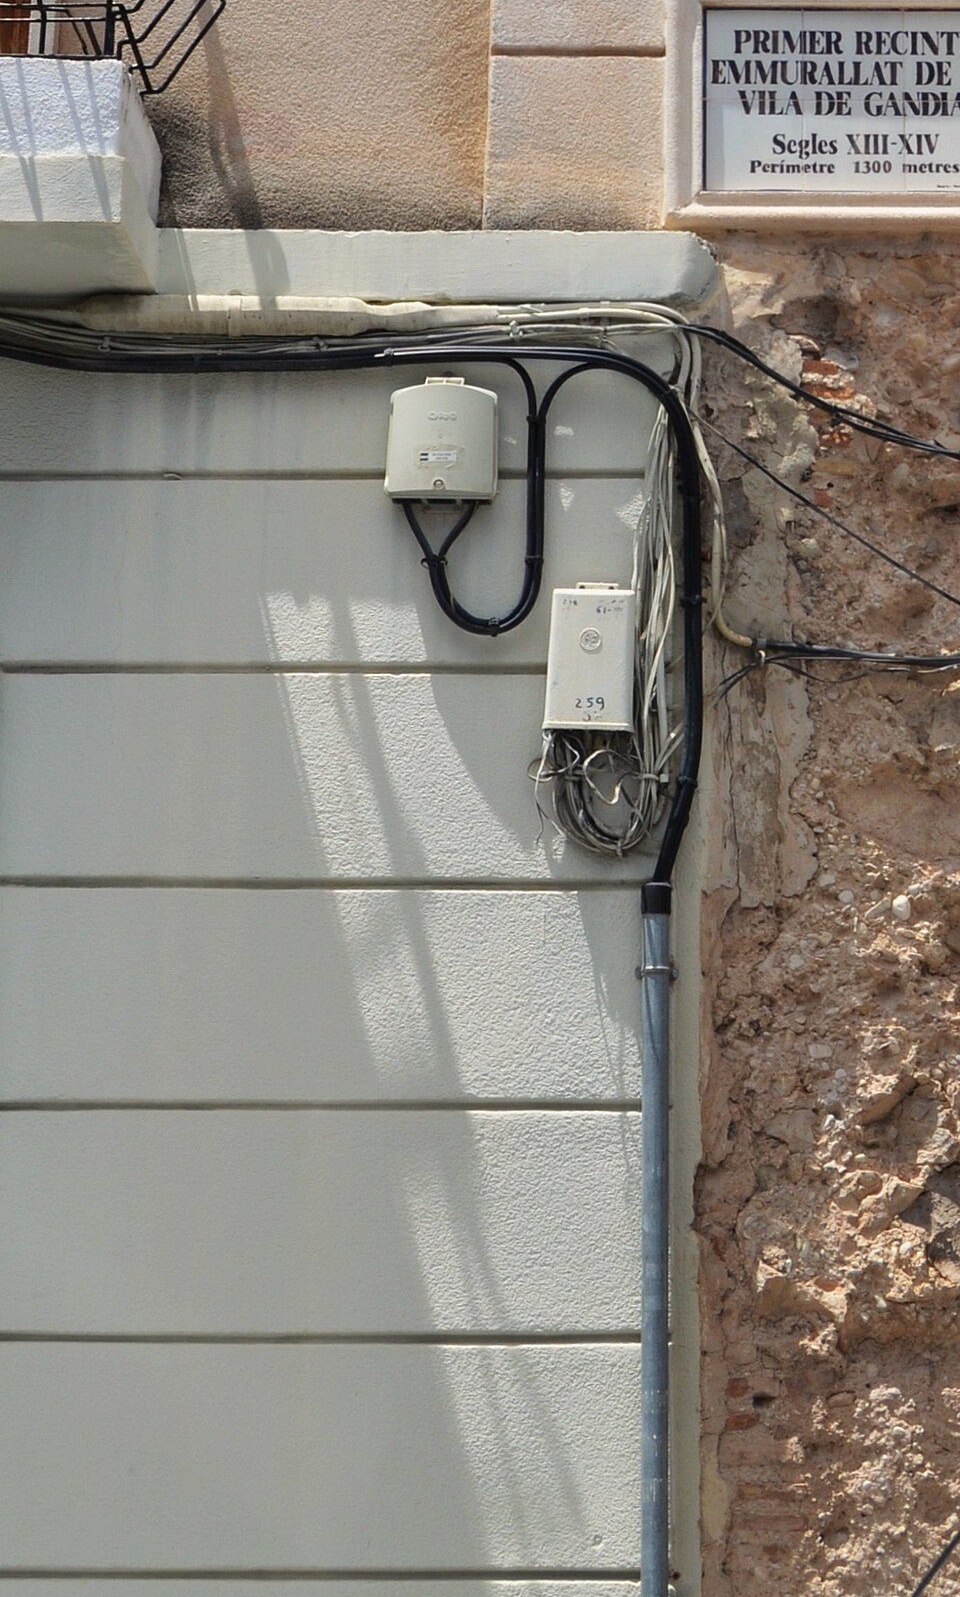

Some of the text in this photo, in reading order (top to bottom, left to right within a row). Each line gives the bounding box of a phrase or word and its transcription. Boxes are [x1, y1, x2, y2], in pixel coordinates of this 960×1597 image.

[733, 30, 843, 55] PRIMER
[711, 59, 902, 86] EMMURALLAT
[915, 61, 951, 86] DE
[738, 90, 802, 116] VILA
[815, 91, 851, 116] DE
[772, 132, 939, 160] Segles XIII-XIV
[750, 159, 960, 174] Perímetre 1300 metres
[575, 696, 605, 711] 259
